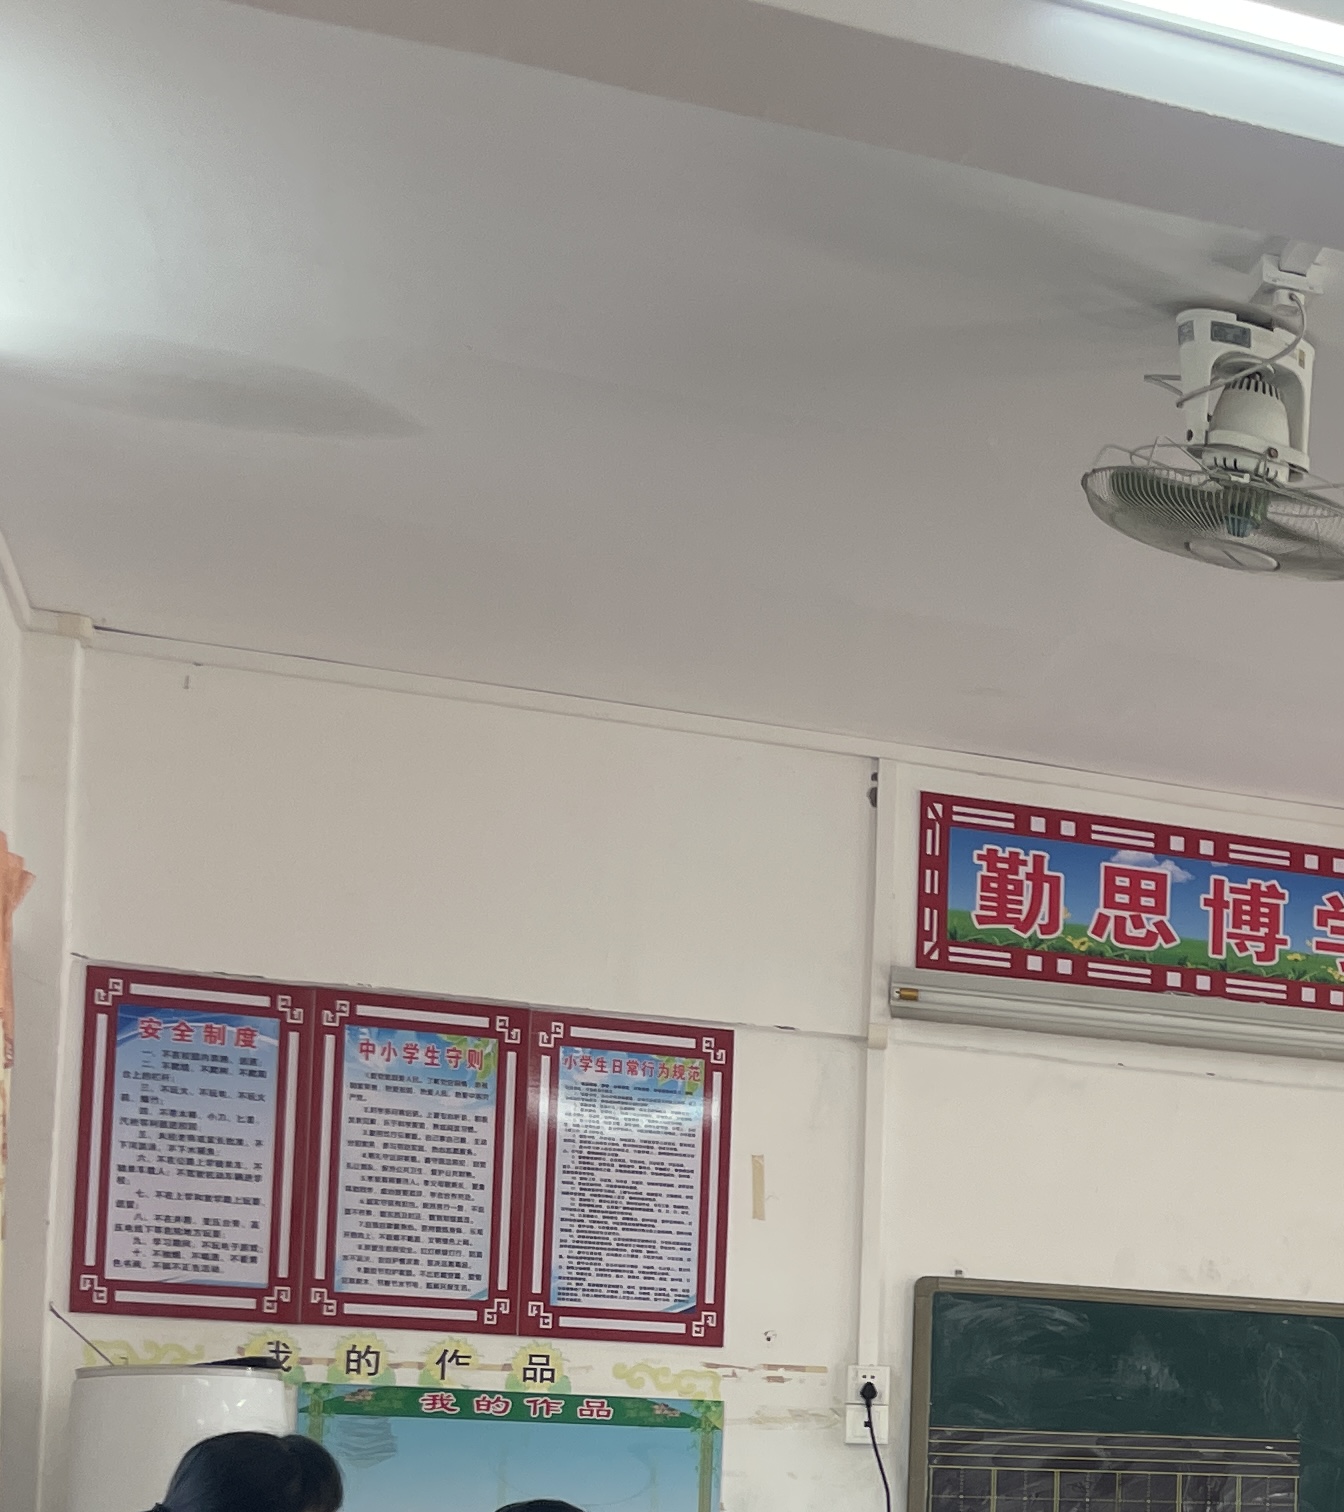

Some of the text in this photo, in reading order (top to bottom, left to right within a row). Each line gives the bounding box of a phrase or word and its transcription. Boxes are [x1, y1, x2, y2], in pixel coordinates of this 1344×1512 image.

[138, 1016, 259, 1049] 安全制度
[358, 1038, 485, 1071] 中小学生守则
[563, 1053, 702, 1082] 小学生日常行为规范
[419, 1392, 613, 1421] 我的作品
